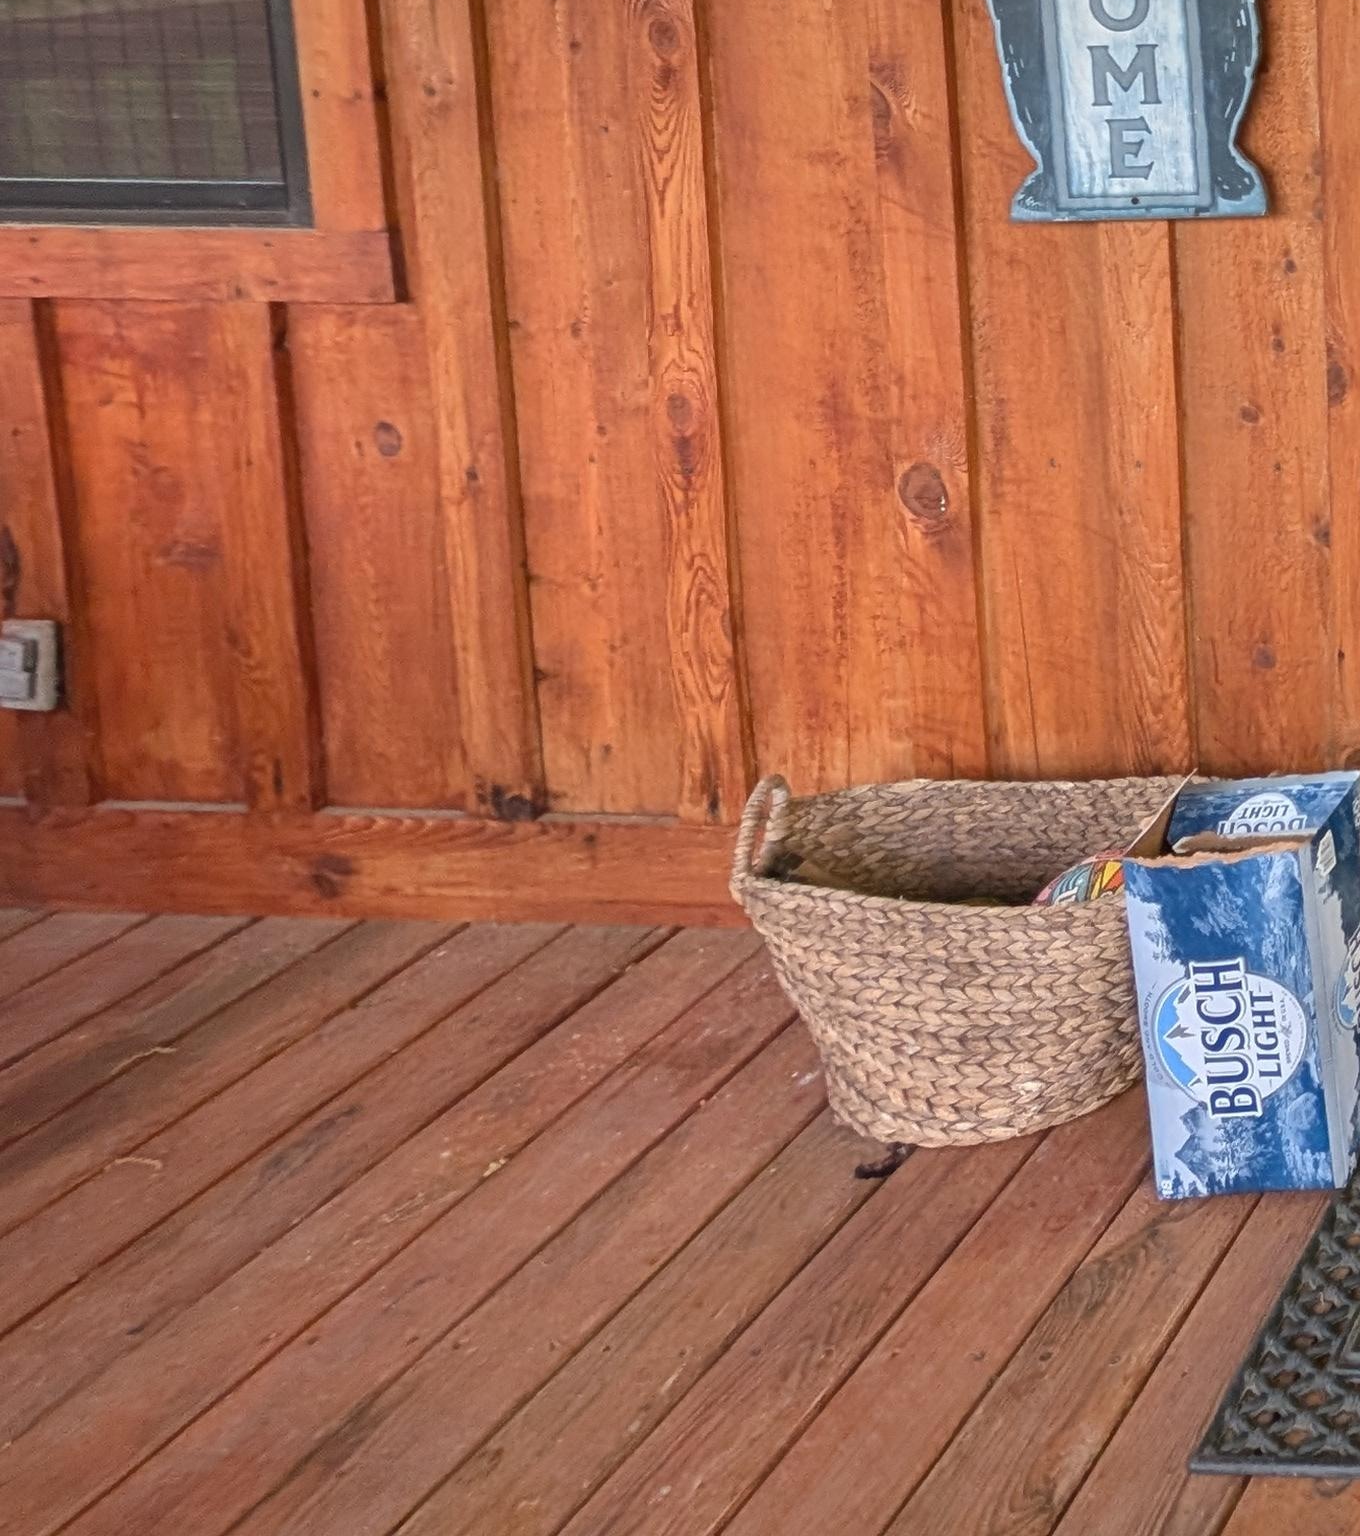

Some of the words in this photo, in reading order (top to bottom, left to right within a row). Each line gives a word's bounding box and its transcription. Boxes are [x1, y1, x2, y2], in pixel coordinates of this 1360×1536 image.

[1237, 804, 1291, 820] LIGHT
[1191, 962, 1259, 1116] BUSCH
[1249, 990, 1282, 1078] LIGHT
